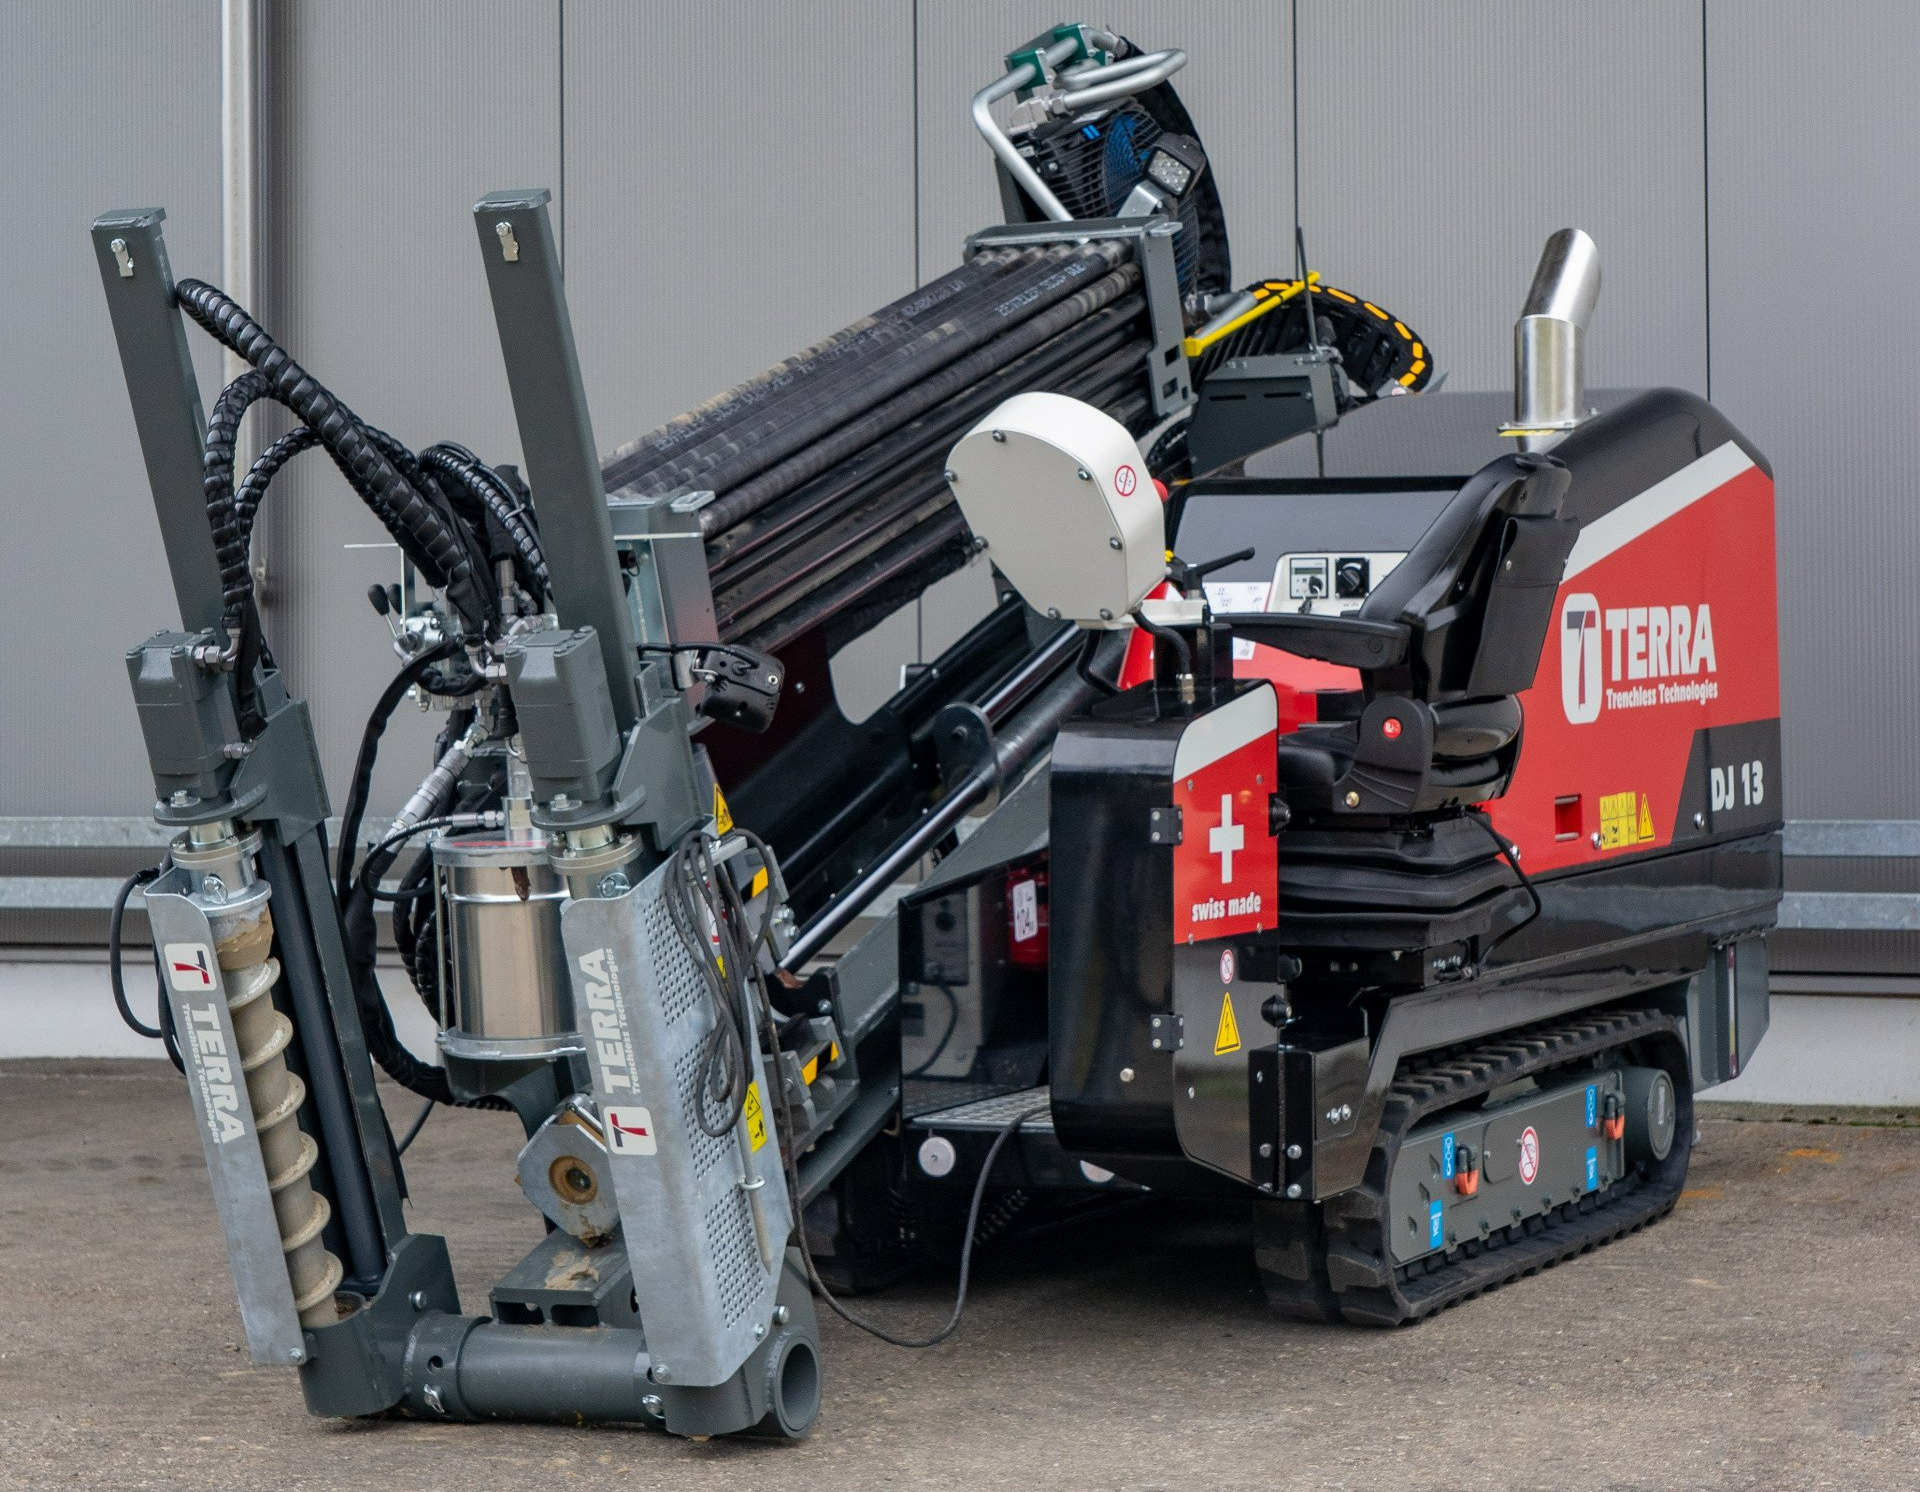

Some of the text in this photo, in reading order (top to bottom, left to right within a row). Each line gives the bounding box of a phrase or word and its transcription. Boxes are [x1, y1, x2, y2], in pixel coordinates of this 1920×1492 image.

[1605, 604, 1716, 682] TERRA
[1606, 679, 1719, 710] Trenchless Technologies
[1711, 760, 1764, 812] DJ 13
[1192, 891, 1262, 922] swiss made
[182, 1003, 221, 1144] Trenchless Technologies
[191, 1003, 246, 1144] TERRA
[578, 947, 632, 1094] TERRA
[605, 947, 642, 1095] Trenchless Technologies
